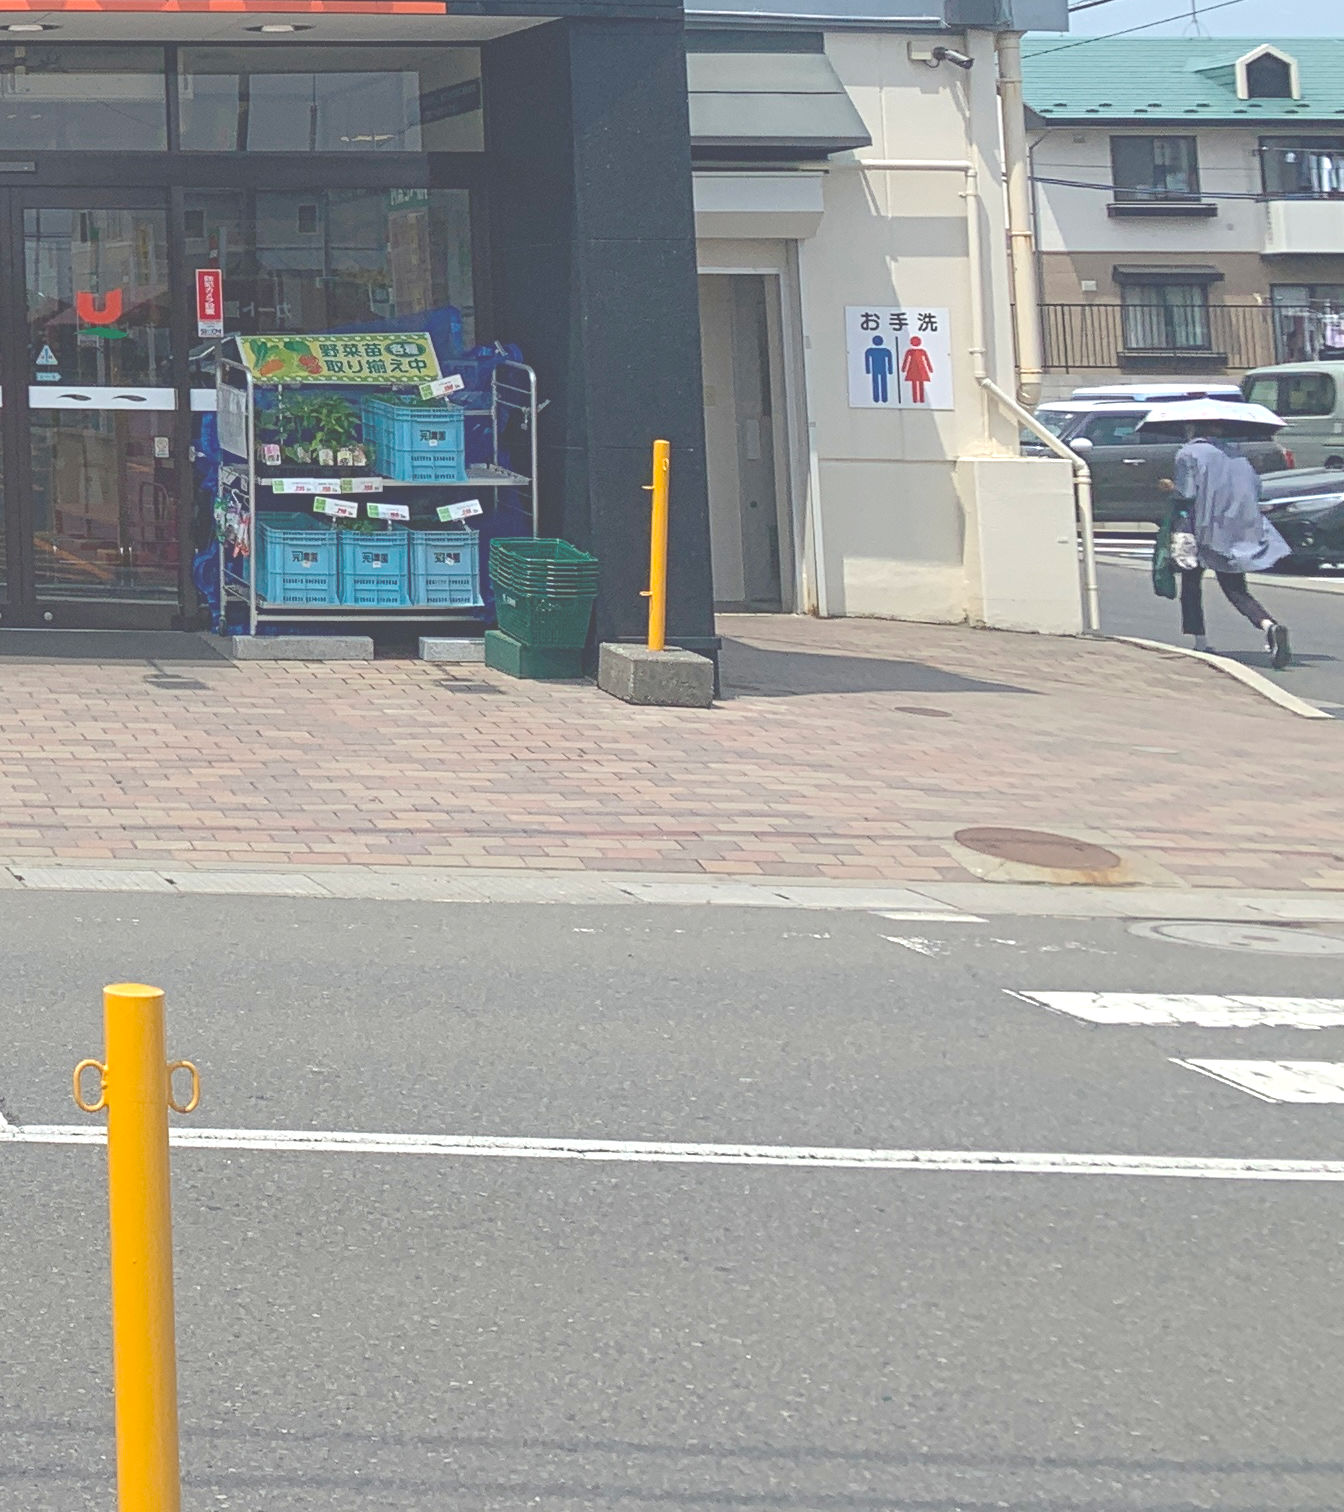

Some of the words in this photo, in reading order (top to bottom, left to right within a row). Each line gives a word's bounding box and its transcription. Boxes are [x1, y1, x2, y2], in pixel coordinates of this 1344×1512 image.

[860, 312, 938, 332] お手洗
[318, 342, 383, 358] 野菜苗
[326, 358, 428, 375] 取り揃え中
